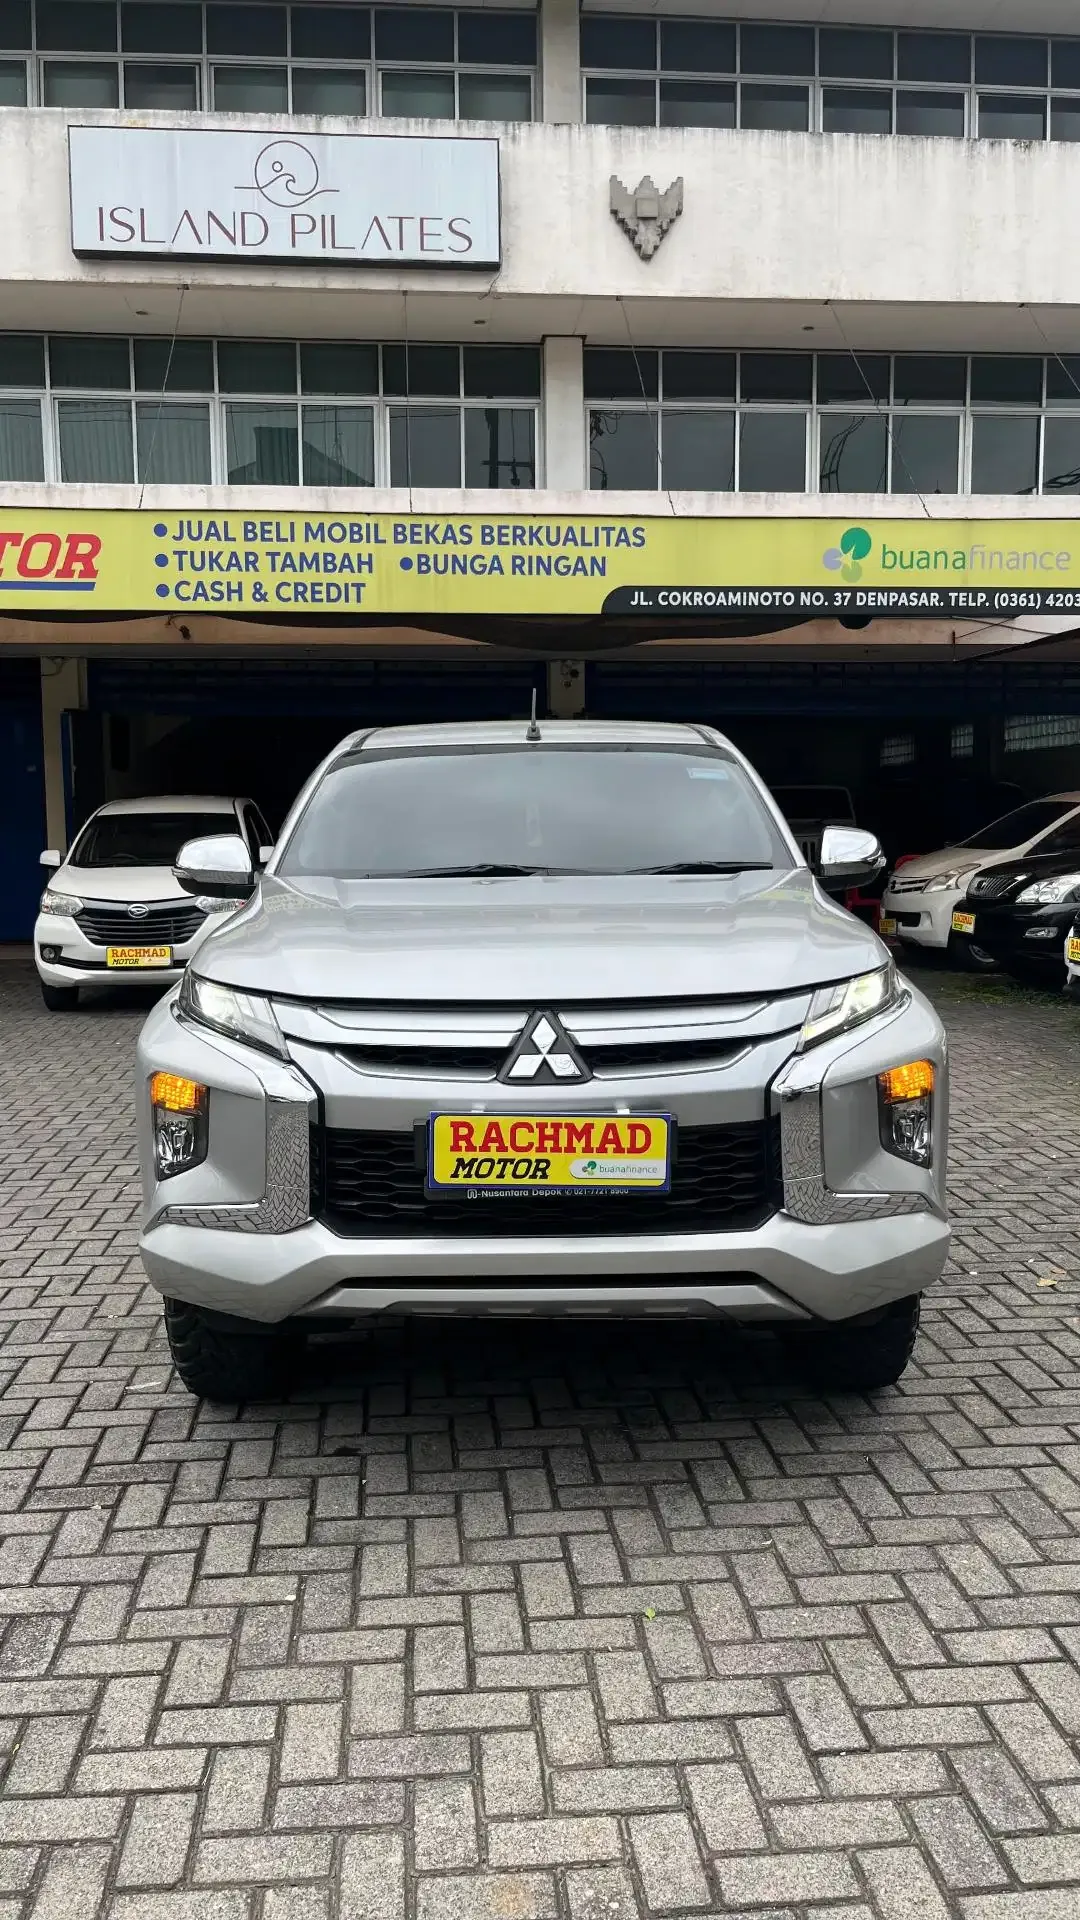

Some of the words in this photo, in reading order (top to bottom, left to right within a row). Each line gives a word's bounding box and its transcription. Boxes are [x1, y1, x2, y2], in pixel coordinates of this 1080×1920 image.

[99, 206, 269, 247] ISLAND
[290, 213, 473, 253] PILATES
[172, 520, 236, 542] JUAL
[244, 521, 295, 543] BELI
[304, 522, 386, 544] MOBIL
[393, 523, 472, 546] BEKAS
[481, 525, 646, 548] BERKUALITAS
[172, 550, 259, 572] TUKAR
[265, 551, 373, 574] TAMBAH
[417, 554, 504, 575] BUNGA
[511, 555, 606, 577] RINGAN
[881, 543, 1071, 571] buanafinance
[174, 580, 243, 602] CASH
[252, 582, 268, 602] &
[275, 582, 366, 604] CREDIT
[630, 591, 652, 606] JL.
[657, 591, 795, 606] COKROAMINOTO
[800, 592, 828, 606] NO.
[833, 592, 851, 606] 37
[856, 592, 944, 607] DENPASAR.
[949, 592, 989, 607] TELP.
[994, 592, 1041, 610] (0361)
[1045, 593, 1080, 607] 4203
[111, 948, 166, 957] RACHMAD
[450, 1121, 652, 1154] RACHMAD
[450, 1157, 551, 1180] MOTOR
[599, 1165, 658, 1174] buanafinance
